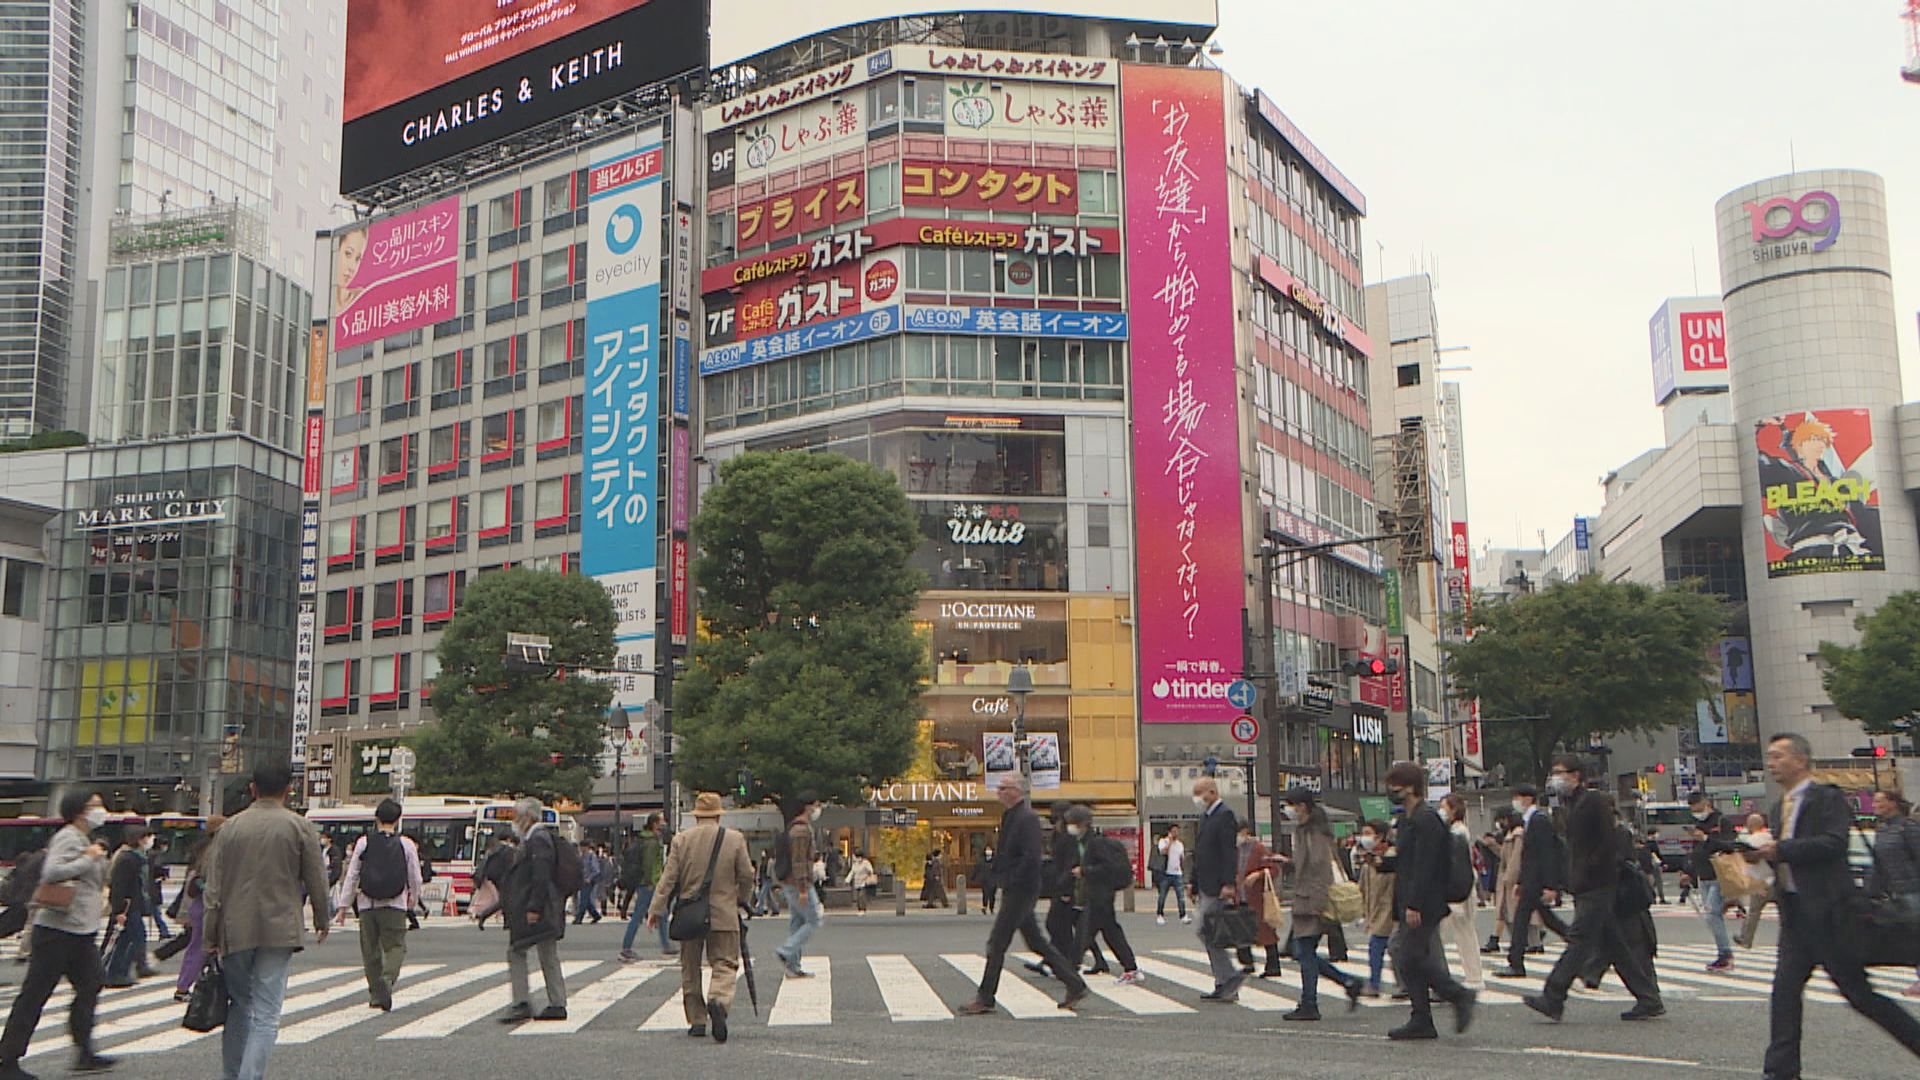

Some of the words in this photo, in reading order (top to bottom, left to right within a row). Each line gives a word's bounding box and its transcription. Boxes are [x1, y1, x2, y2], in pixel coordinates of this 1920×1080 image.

[928, 50, 1107, 79] しゃぶしゃぶバイキング
[402, 89, 503, 146] CHARLES
[518, 77, 533, 102] &
[550, 41, 623, 90] KEITH
[721, 63, 854, 123] しゃぶしゃぶバイキング
[1004, 92, 1108, 128] しゃぶ葉
[780, 103, 858, 151] しゃぶ葉
[596, 153, 655, 190] 当ビル5F
[711, 148, 734, 171] 9F
[904, 166, 1072, 204] コンタクト
[740, 177, 862, 240] プライス
[1743, 190, 1841, 252] 109
[389, 211, 454, 248] 品川スキン
[1023, 224, 1103, 257] ガスト
[389, 234, 446, 269] クリニック
[811, 229, 873, 270] ガスト
[1752, 241, 1808, 262] SHIBUYA
[595, 255, 652, 286] eyecity
[350, 283, 451, 337] 品川美容外科
[742, 298, 774, 321] Café
[777, 277, 855, 329] ガスト
[708, 307, 735, 336] 7F
[871, 314, 890, 330] 6F
[912, 310, 962, 328] AEON
[975, 310, 1123, 333] 英会話イーオン
[1687, 318, 1722, 340] UN
[705, 346, 740, 368] AEON
[751, 319, 864, 360] 英会話イーオン
[1689, 342, 1727, 368] QL
[591, 329, 624, 529] アイシティ
[624, 323, 648, 524] コンタクトの
[114, 489, 186, 505] SHIBUYA
[1766, 477, 1872, 510] BLEACH
[77, 505, 154, 526] MARK
[164, 500, 226, 518] CITY
[947, 518, 1026, 544] Ushi8
[604, 582, 639, 599] ONTACT
[941, 601, 1036, 619] L'OCCITANE
[971, 697, 1009, 717] Café
[1353, 713, 1383, 745] LUSH
